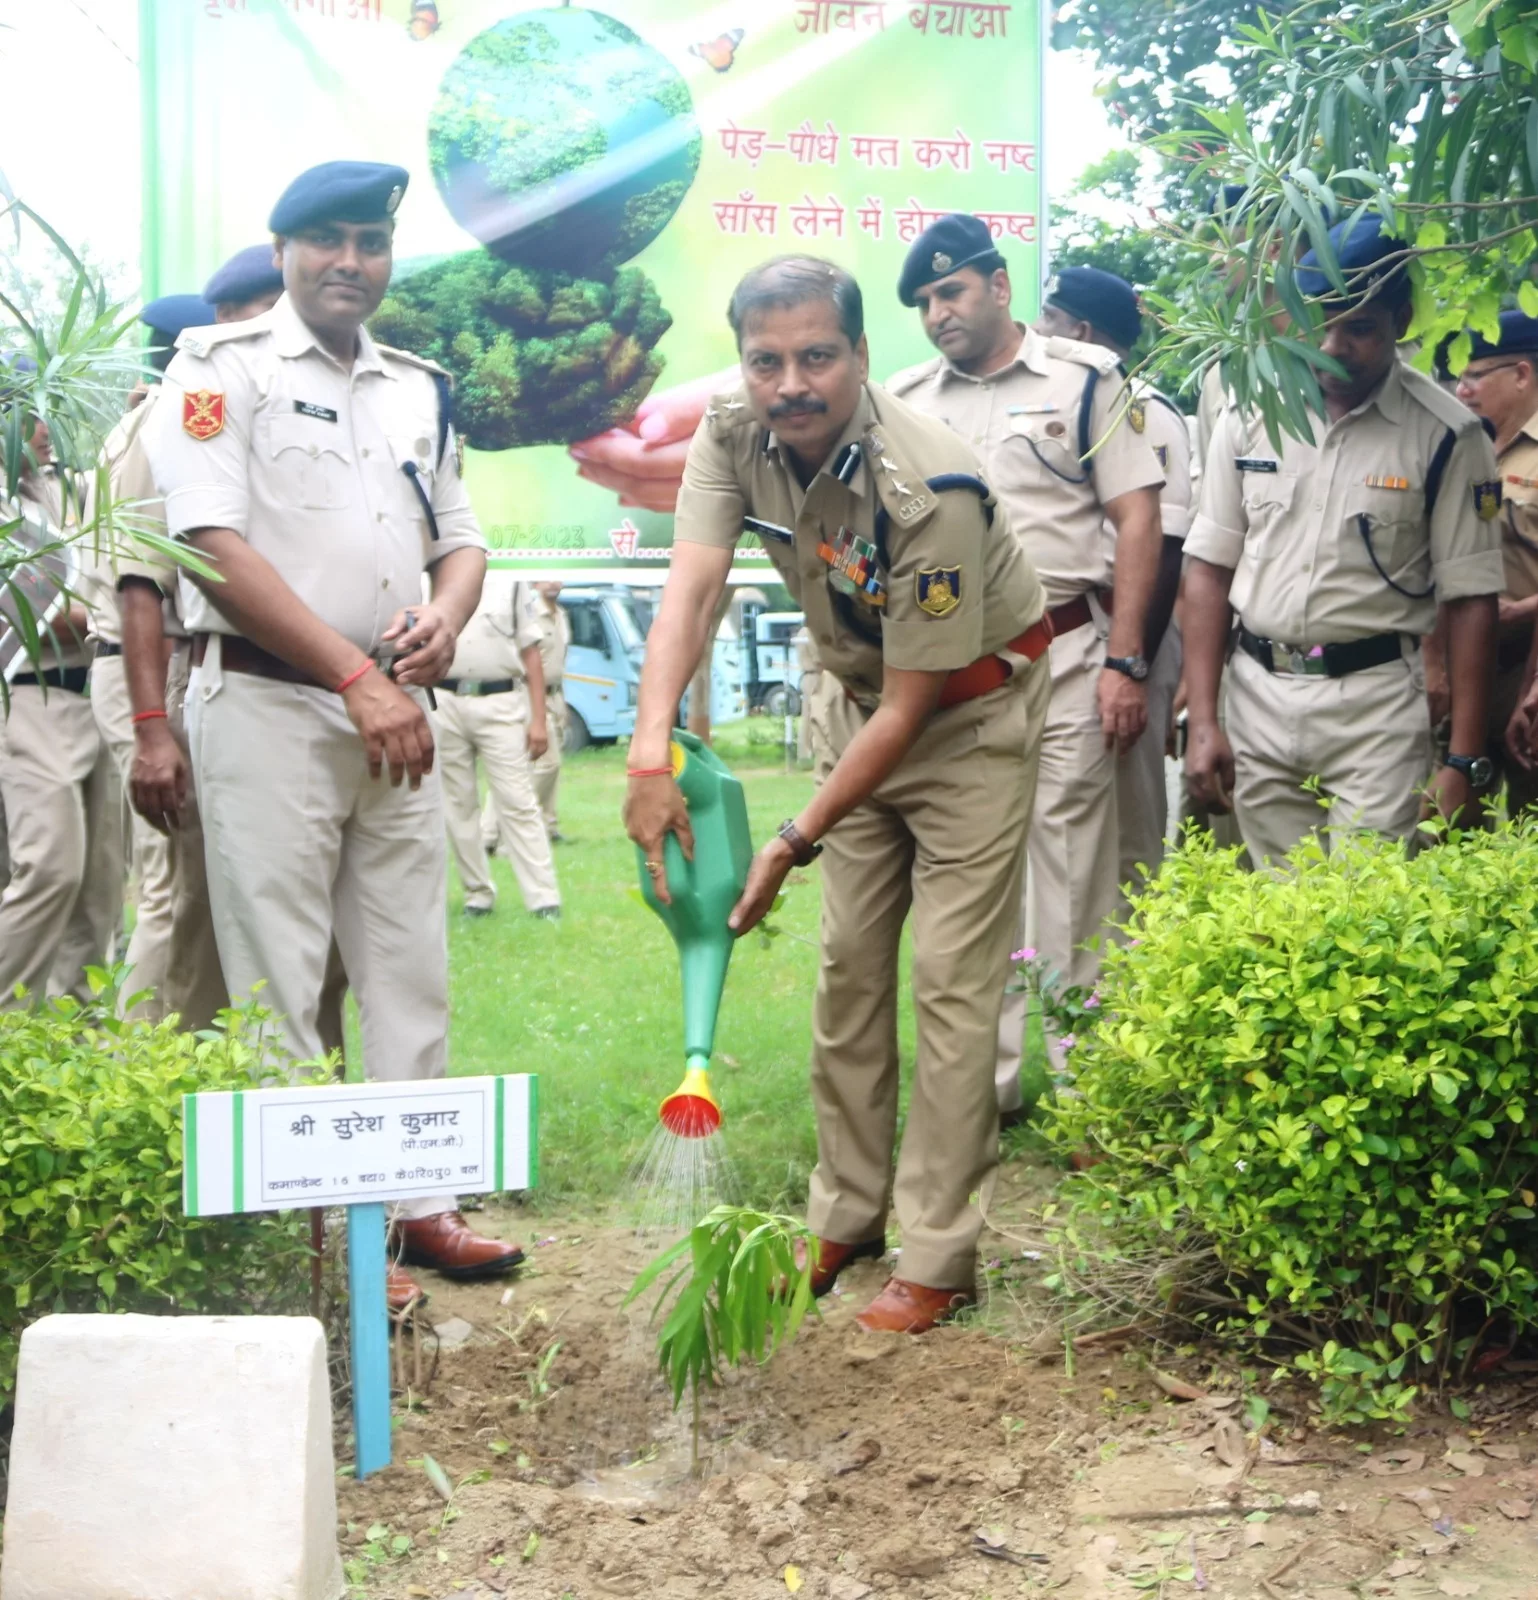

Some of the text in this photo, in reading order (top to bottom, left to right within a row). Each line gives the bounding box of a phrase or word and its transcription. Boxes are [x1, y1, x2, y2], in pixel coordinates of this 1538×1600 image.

[850, 136, 899, 167] मत
[912, 130, 971, 171] करो
[712, 190, 778, 235] साँस
[789, 194, 845, 238] लेने
[856, 196, 882, 238] में
[611, 519, 636, 556] से
[290, 1110, 460, 1140] श्री सुरेश कुमार
